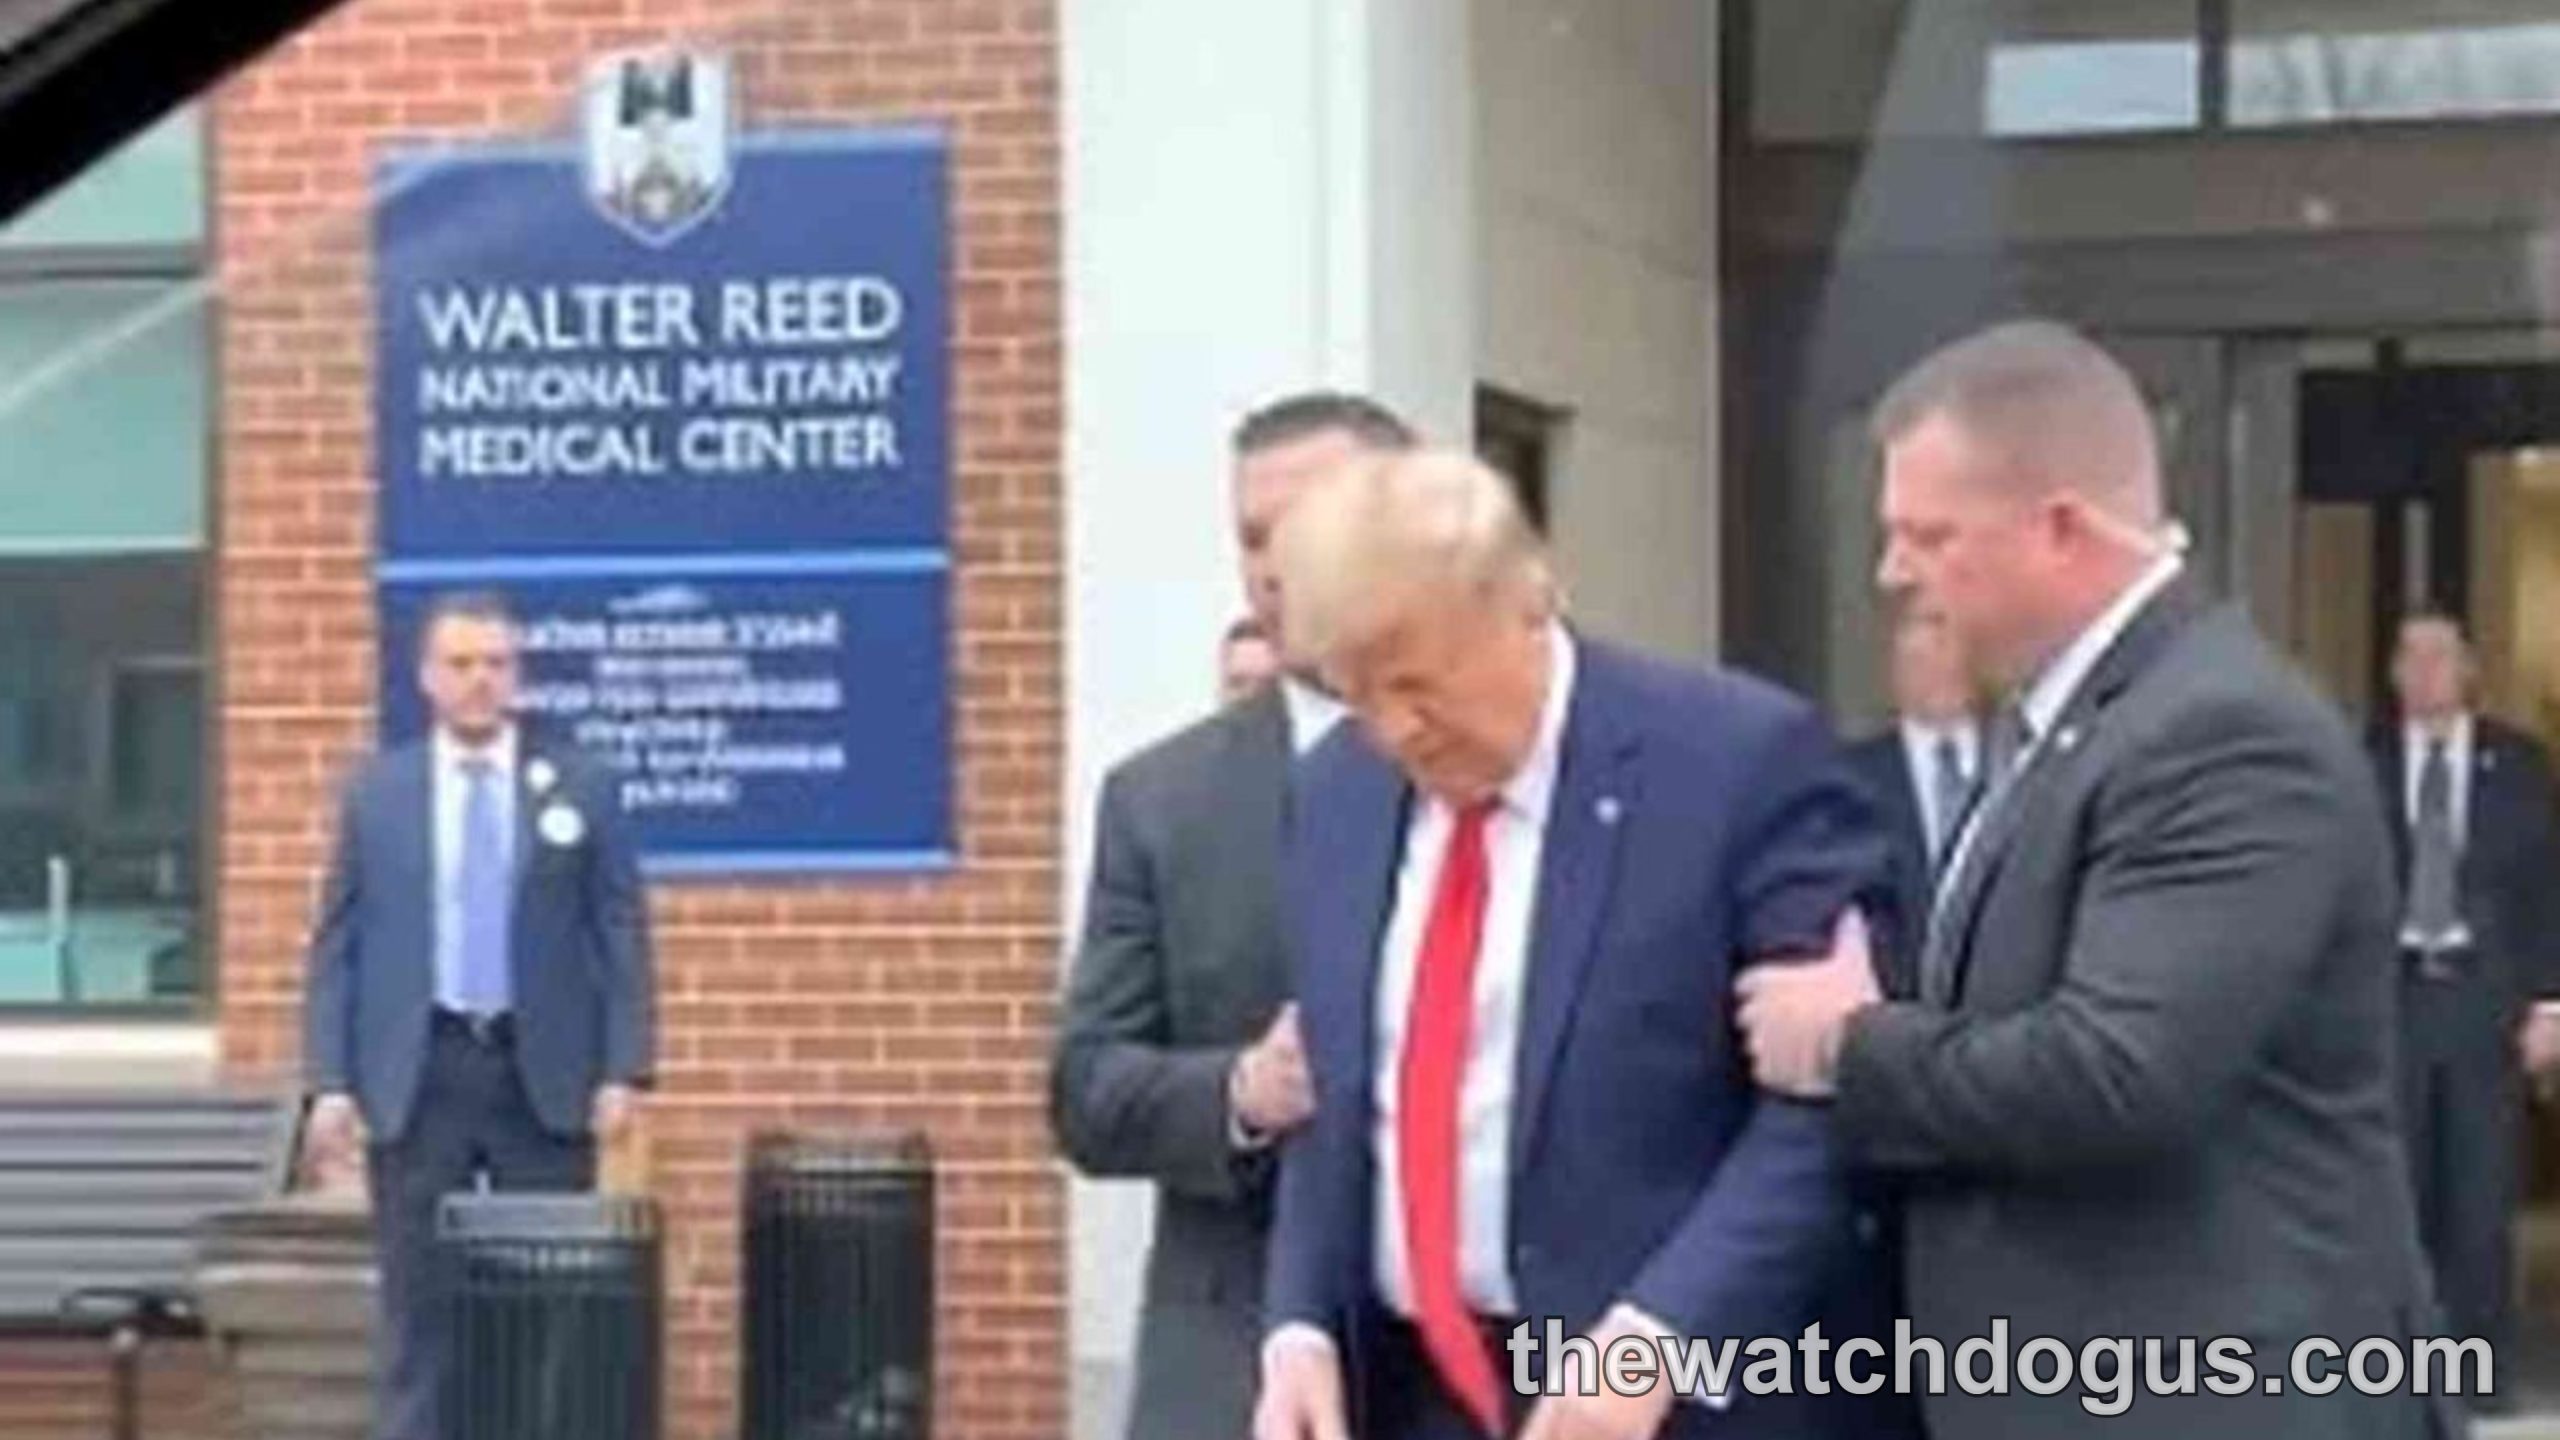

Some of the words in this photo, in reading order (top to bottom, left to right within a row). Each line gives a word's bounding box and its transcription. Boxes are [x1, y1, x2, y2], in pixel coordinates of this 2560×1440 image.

[418, 282, 699, 350] WALTER
[719, 276, 902, 345] REED
[418, 362, 670, 413] NATIONAL
[681, 353, 901, 407] MILITARY
[418, 424, 667, 476] MEDICAL
[678, 415, 902, 472] CENTER
